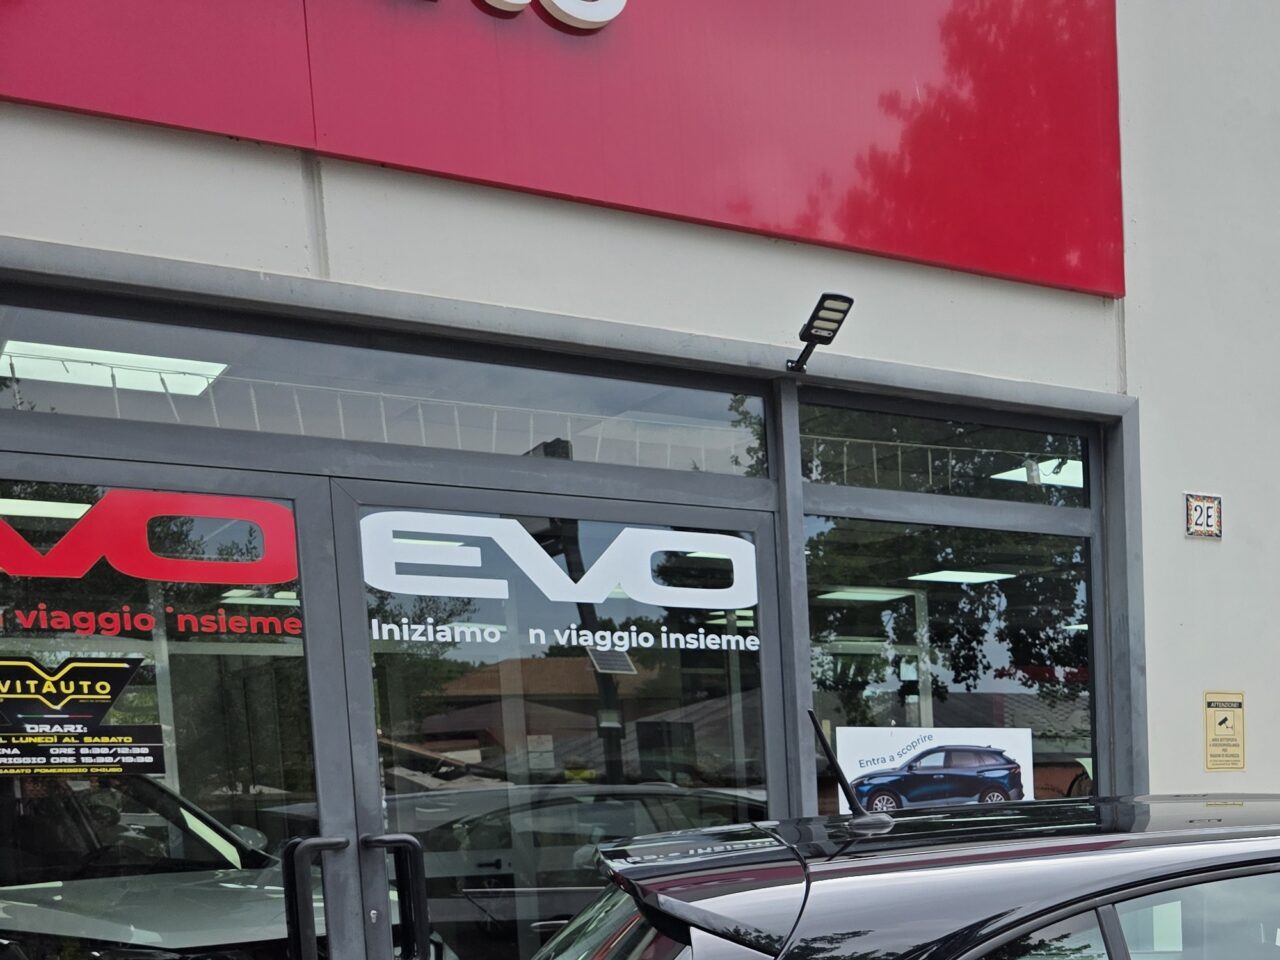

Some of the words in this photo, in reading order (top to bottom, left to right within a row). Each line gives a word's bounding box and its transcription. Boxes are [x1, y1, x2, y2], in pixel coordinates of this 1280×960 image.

[1194, 504, 1214, 528] 2E
[360, 511, 759, 609] EVO
[14, 602, 156, 637] viaggio
[165, 606, 303, 635] nsieme
[371, 618, 501, 643] Iniziamo
[553, 623, 655, 652] viaggio
[660, 626, 760, 651] insieme
[11, 735, 57, 743] LUNEDÌ
[859, 757, 886, 768] Entra
[896, 734, 933, 758] scoprire
